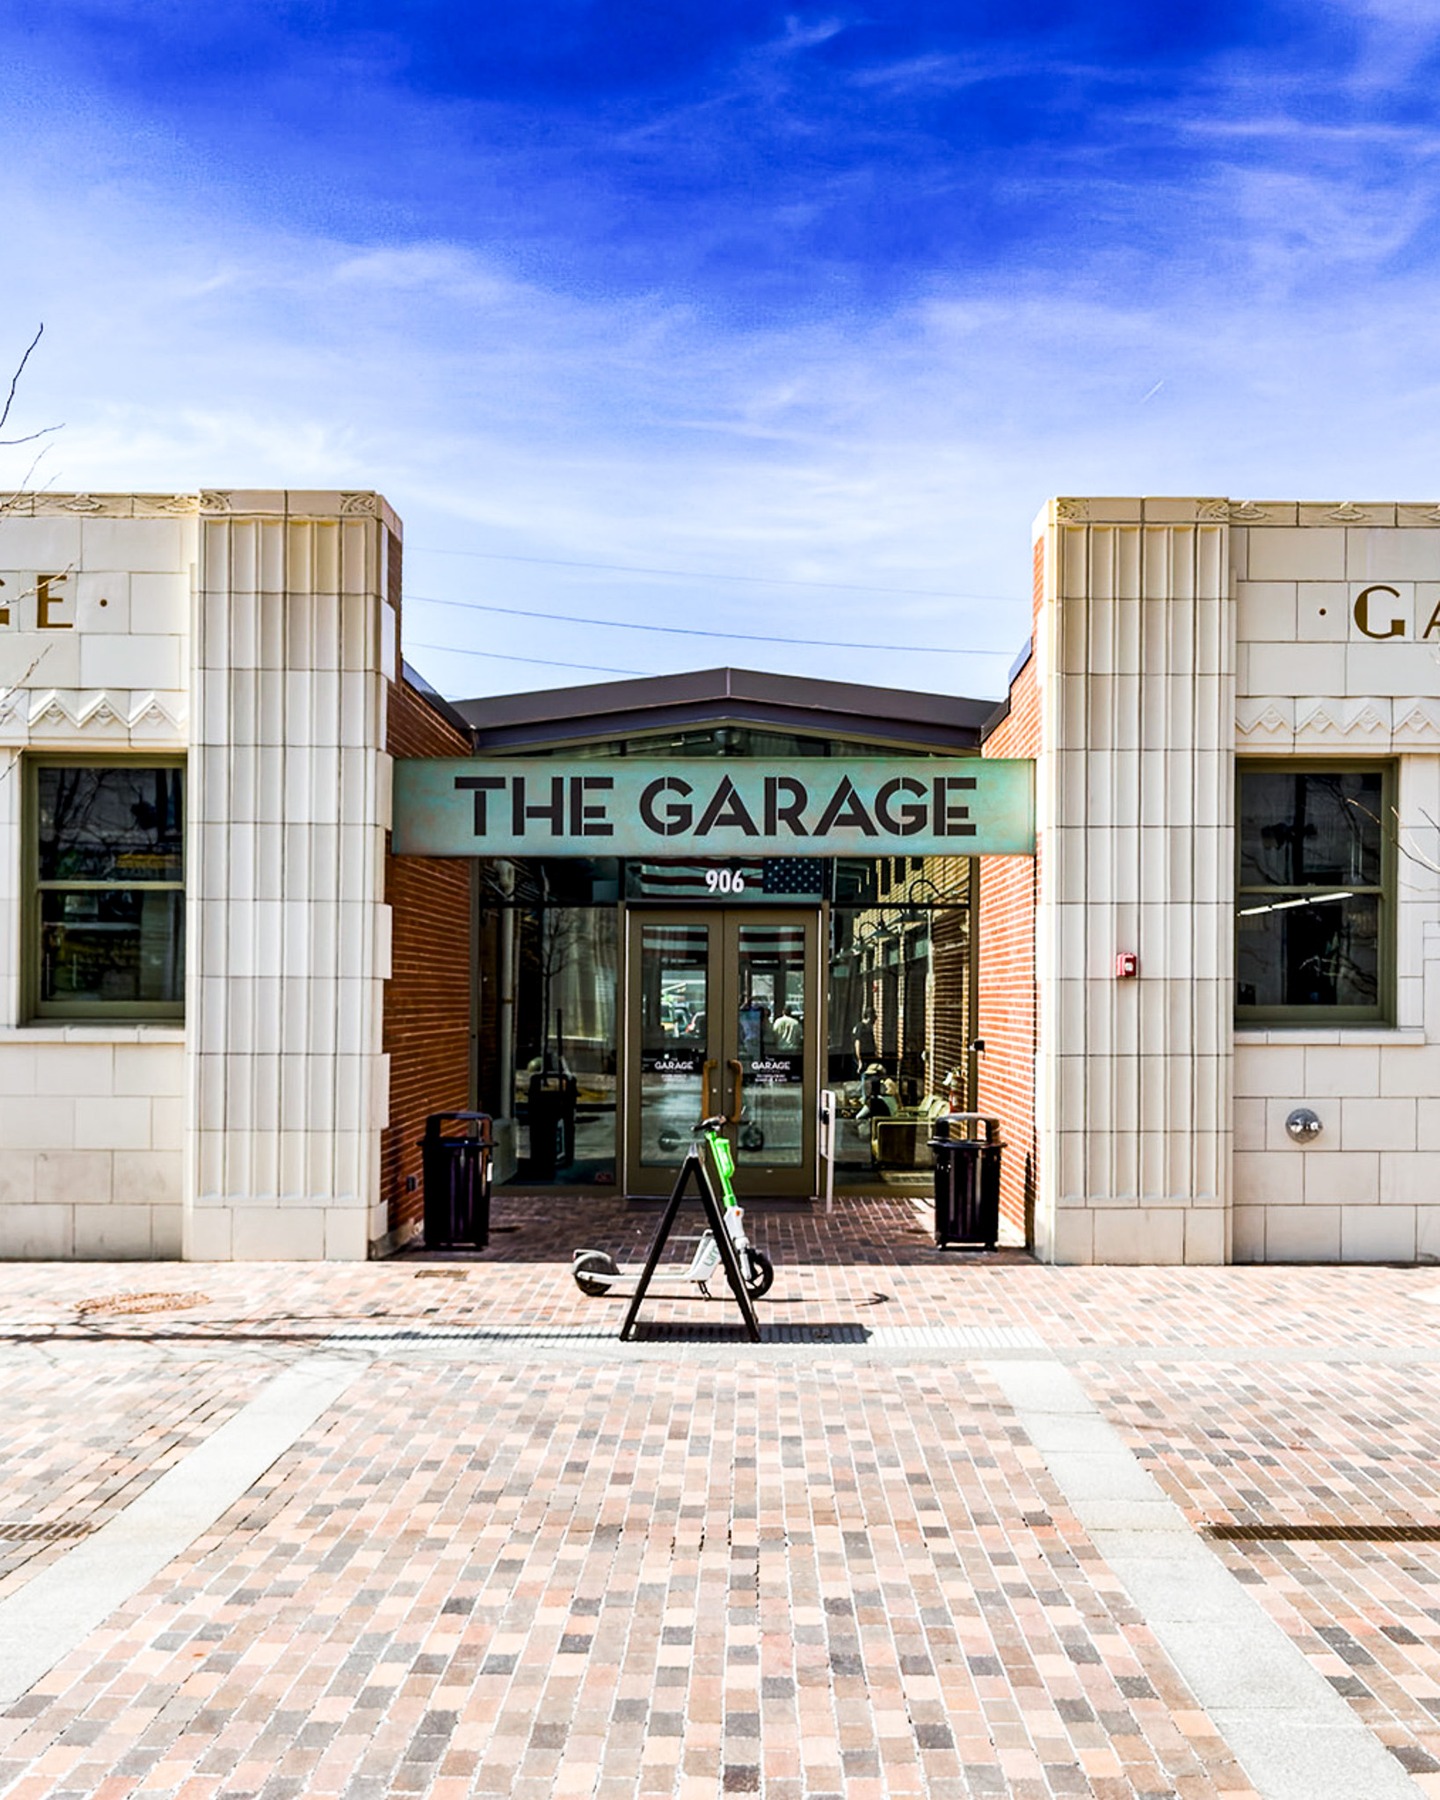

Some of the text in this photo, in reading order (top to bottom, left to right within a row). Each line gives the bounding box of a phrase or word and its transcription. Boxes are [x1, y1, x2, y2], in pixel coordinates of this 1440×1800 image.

[454, 774, 977, 836] THE GARAGE
[705, 869, 745, 893] 906
[654, 1060, 694, 1070] GARAGE
[751, 1060, 791, 1070] GARAGE
